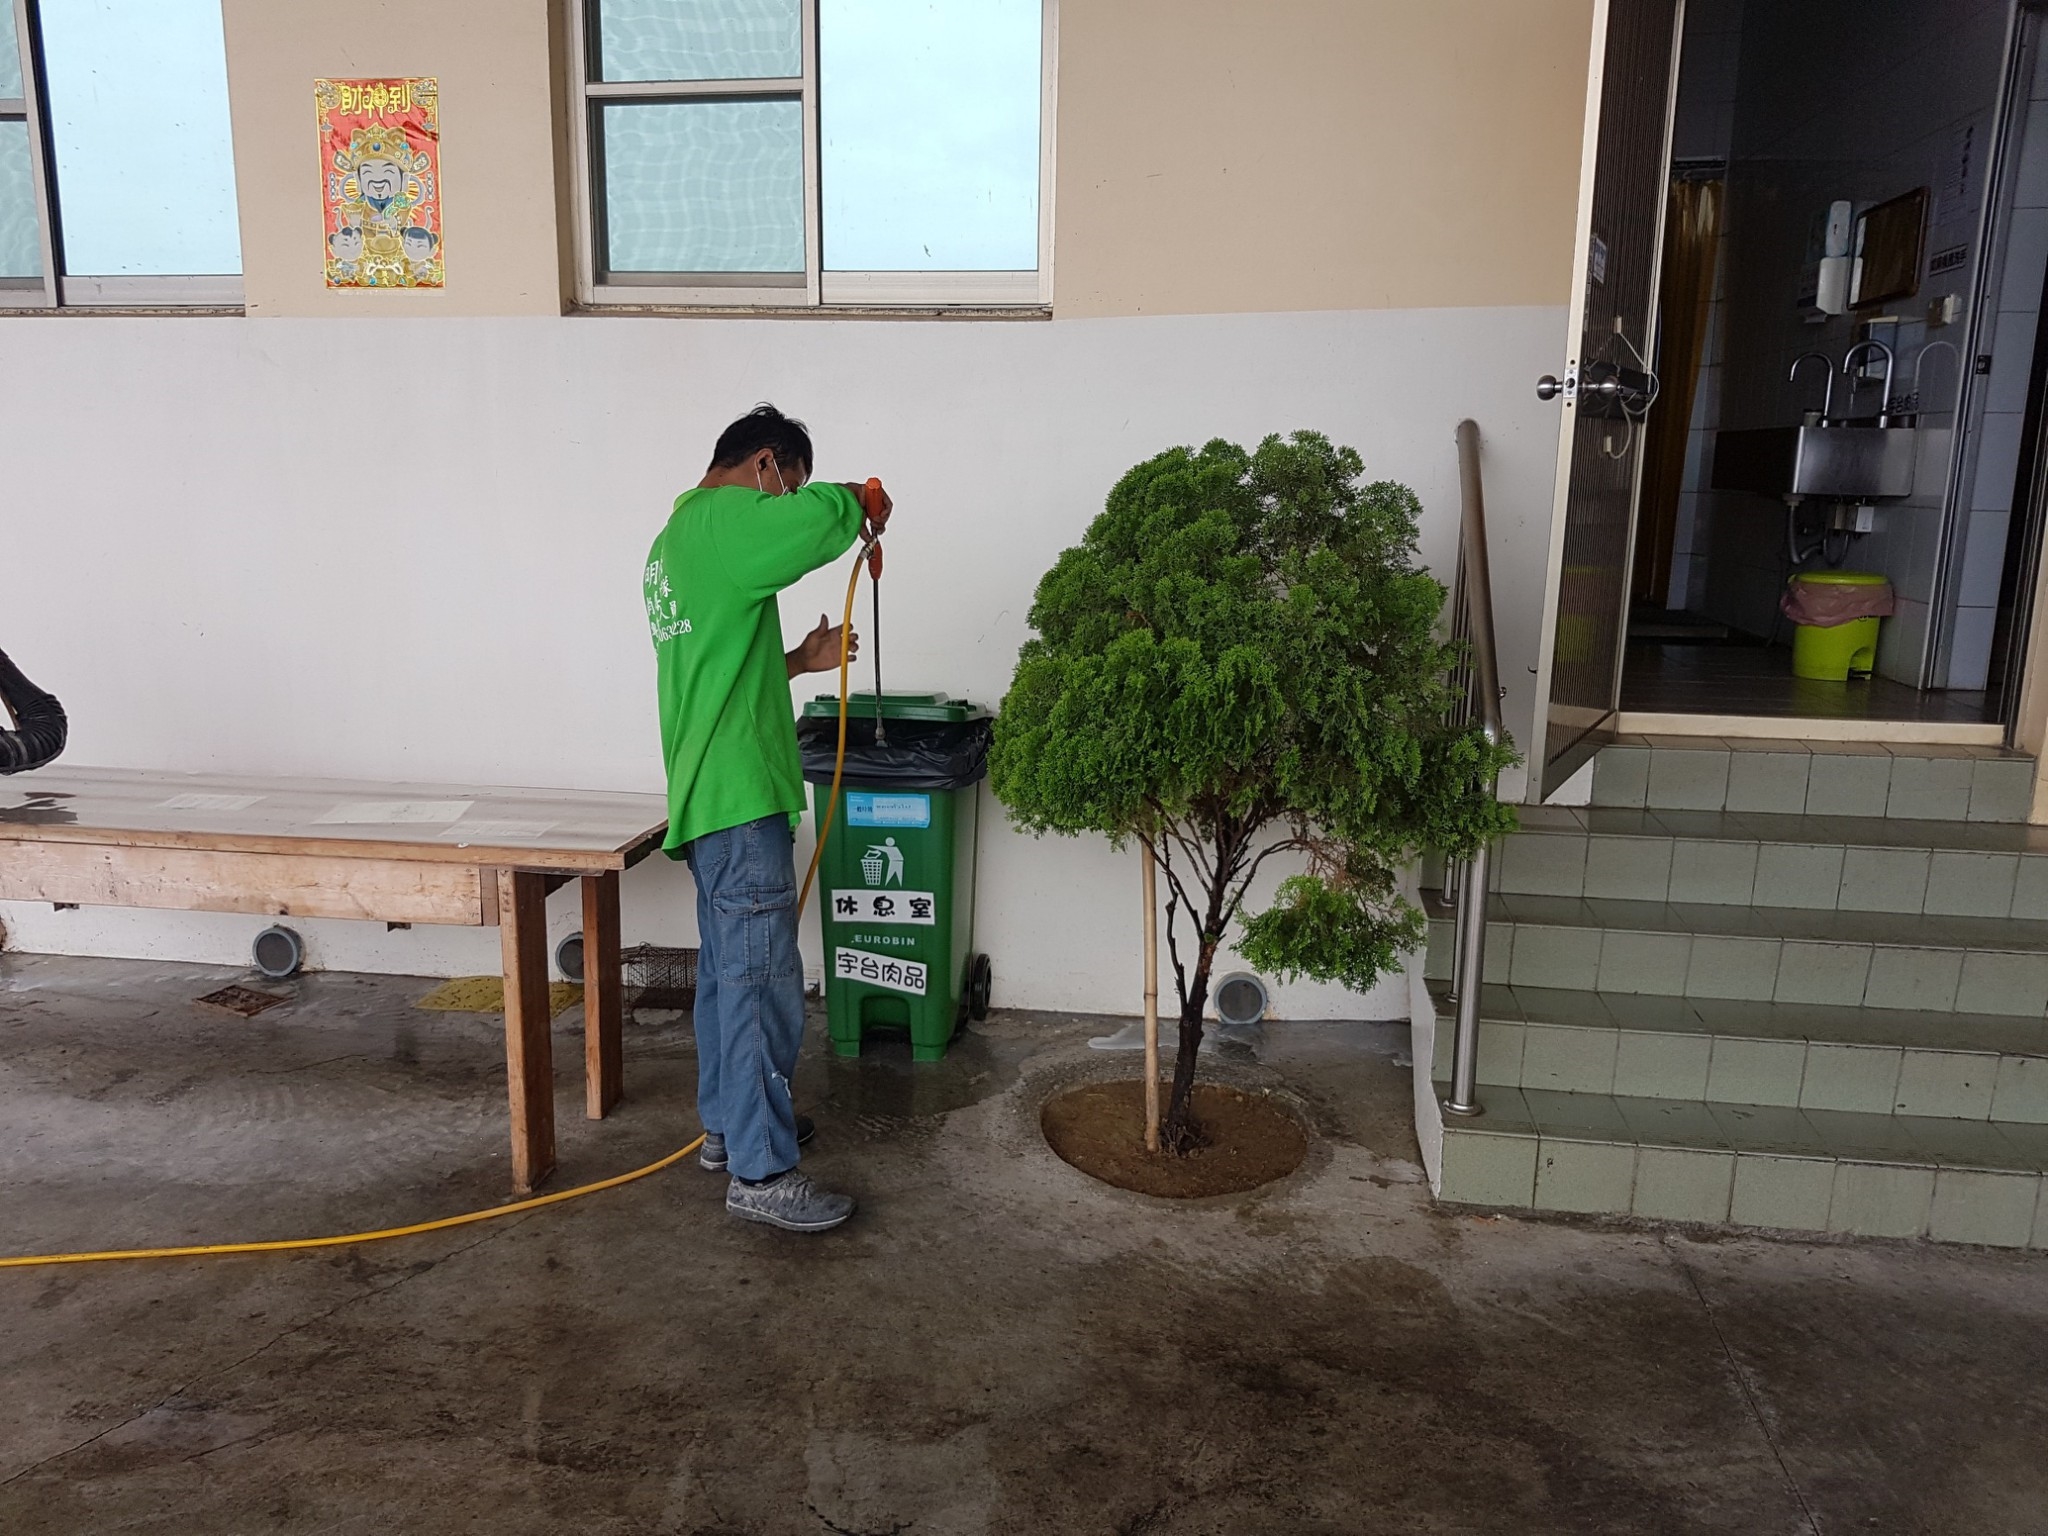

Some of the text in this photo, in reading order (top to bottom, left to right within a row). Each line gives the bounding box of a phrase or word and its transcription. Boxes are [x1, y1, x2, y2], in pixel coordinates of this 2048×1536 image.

[340, 82, 411, 119] 財神到
[836, 896, 931, 918] 休息室
[854, 934, 916, 946] EUROBIN
[838, 952, 925, 989] 宇台肉品
